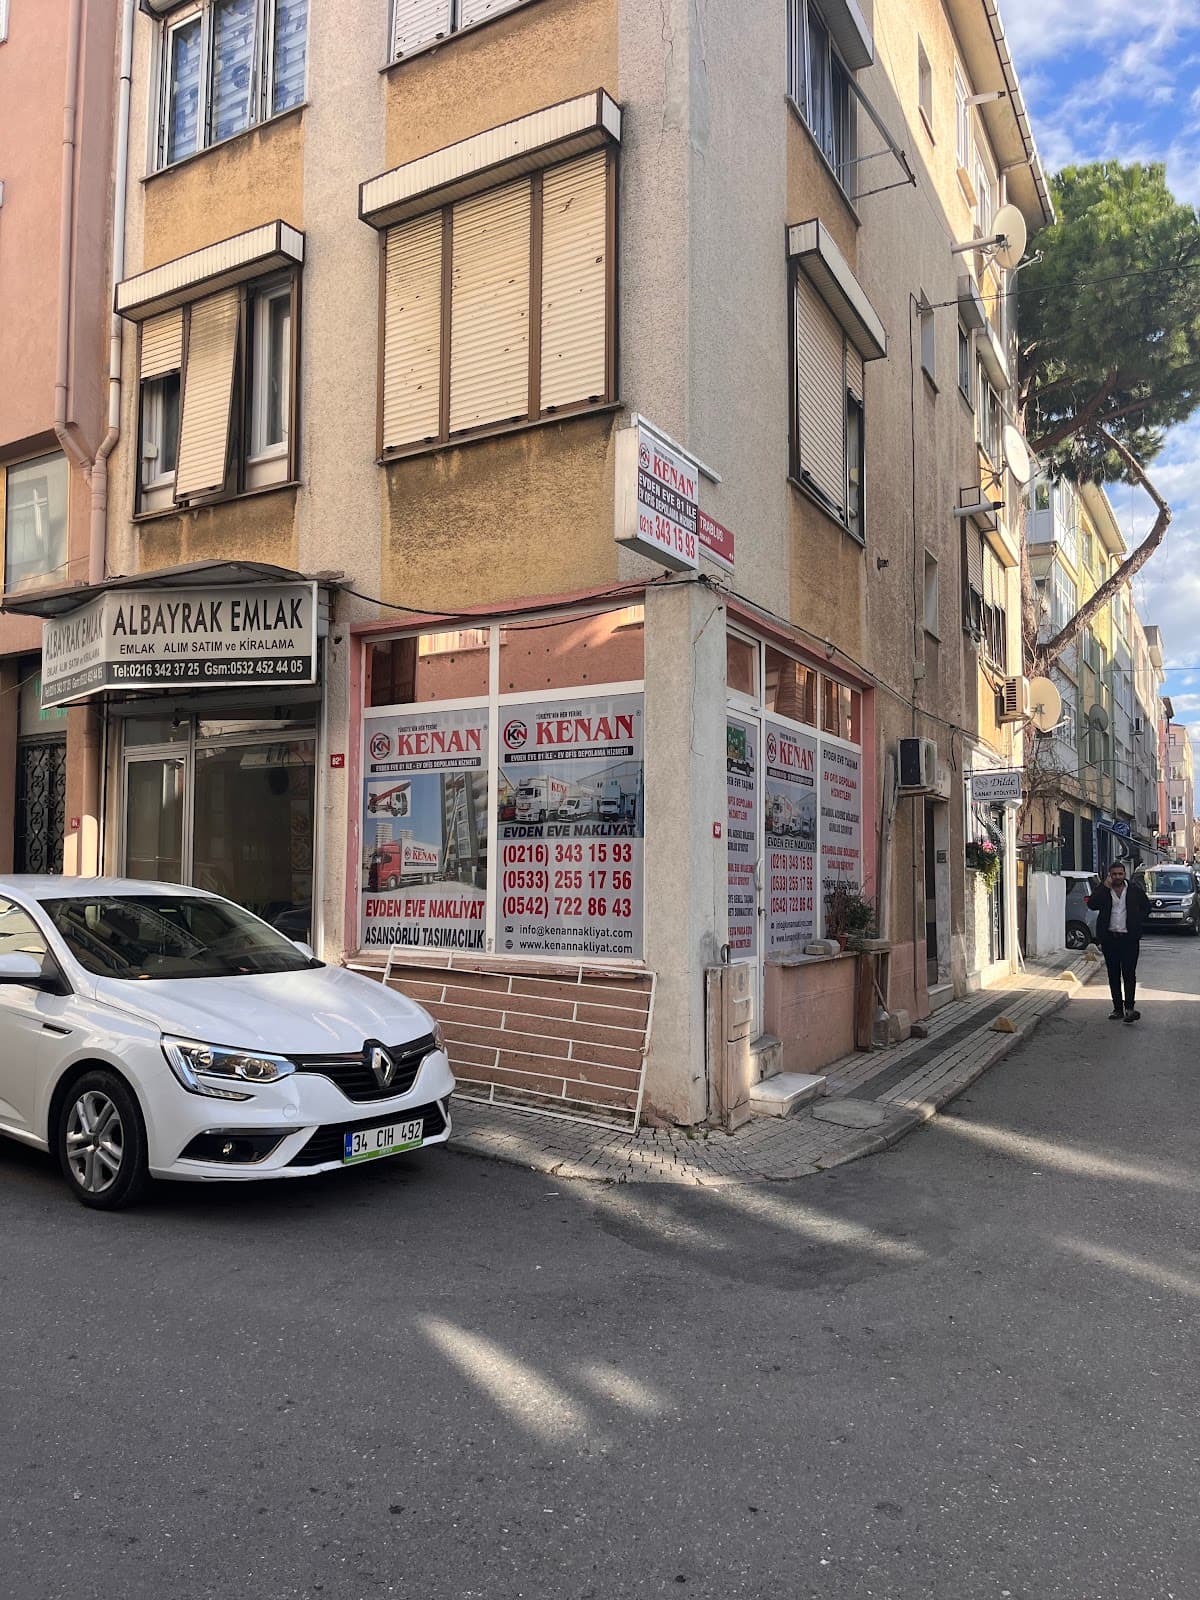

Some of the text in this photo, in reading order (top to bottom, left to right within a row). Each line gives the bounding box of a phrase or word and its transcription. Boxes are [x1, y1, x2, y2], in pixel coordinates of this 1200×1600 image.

[654, 454, 694, 500] KENAN
[640, 474, 660, 496] EVDEN
[662, 488, 675, 506] EVE
[677, 497, 684, 512] 81
[656, 515, 670, 546] 343
[674, 525, 682, 552] 15
[686, 532, 695, 559] 93
[700, 515, 723, 542] TRABLUS
[112, 598, 303, 636] ALBAYRAK EMLAK
[46, 608, 104, 660] ALBAYRAK EMLAK
[120, 643, 155, 655] EMLAK
[164, 642, 188, 653] ALIM
[192, 641, 222, 652] SATIM
[240, 637, 294, 651] KİRALAMA
[113, 660, 303, 677] Tel:0216 342 37 25 Gsm:0532 452 44 05
[536, 714, 634, 745] KENAN
[398, 729, 482, 756] KENAN
[780, 740, 813, 772] KENAN
[990, 776, 1016, 787] Dilde
[504, 825, 544, 838] EVDEN
[547, 825, 570, 836] EVE
[413, 850, 437, 862] KENAN
[503, 844, 632, 867] (0216) 343 15 93
[788, 855, 798, 870] 343
[503, 870, 632, 893] (0533) 255 17 56
[366, 895, 485, 919] EVDEN EVE NAKLİYAT
[503, 896, 632, 919] (0542) 722 86 43
[789, 897, 798, 912] 722
[365, 922, 420, 946] ASANSÖRLÜ
[520, 925, 632, 939] info@kenannakliyat.com
[520, 940, 632, 954] www.kenannakliyat.com
[354, 1122, 420, 1152] 34 CIH 492
